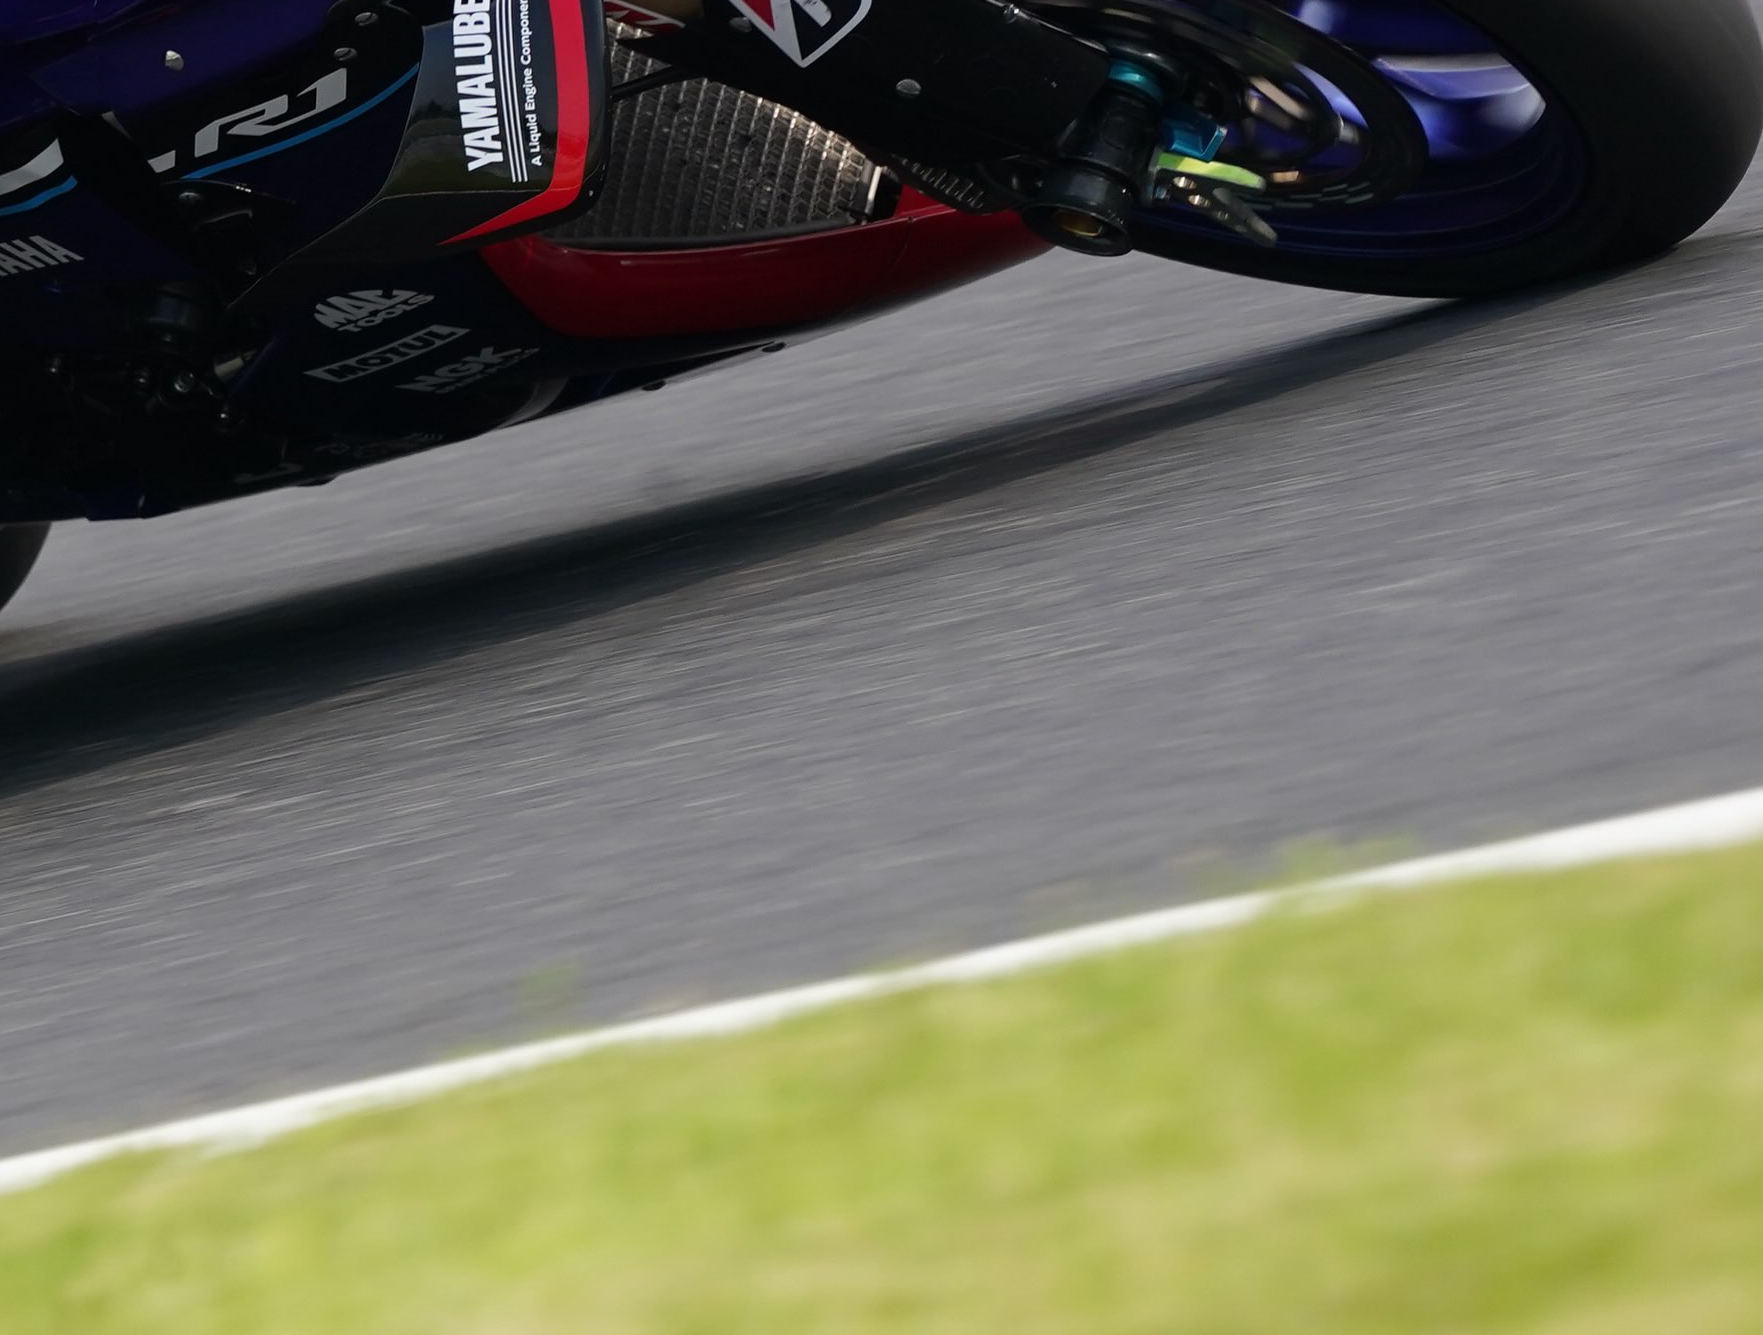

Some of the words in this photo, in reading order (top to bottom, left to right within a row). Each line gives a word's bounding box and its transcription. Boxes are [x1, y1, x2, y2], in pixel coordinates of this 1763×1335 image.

[522, 67, 537, 111] Engine
[525, 113, 541, 154] Liquid
[531, 155, 542, 166] A
[314, 289, 418, 329] MAC
[337, 294, 435, 332] TOOLS
[317, 328, 459, 381] MOTUL
[394, 347, 521, 392] NGK
